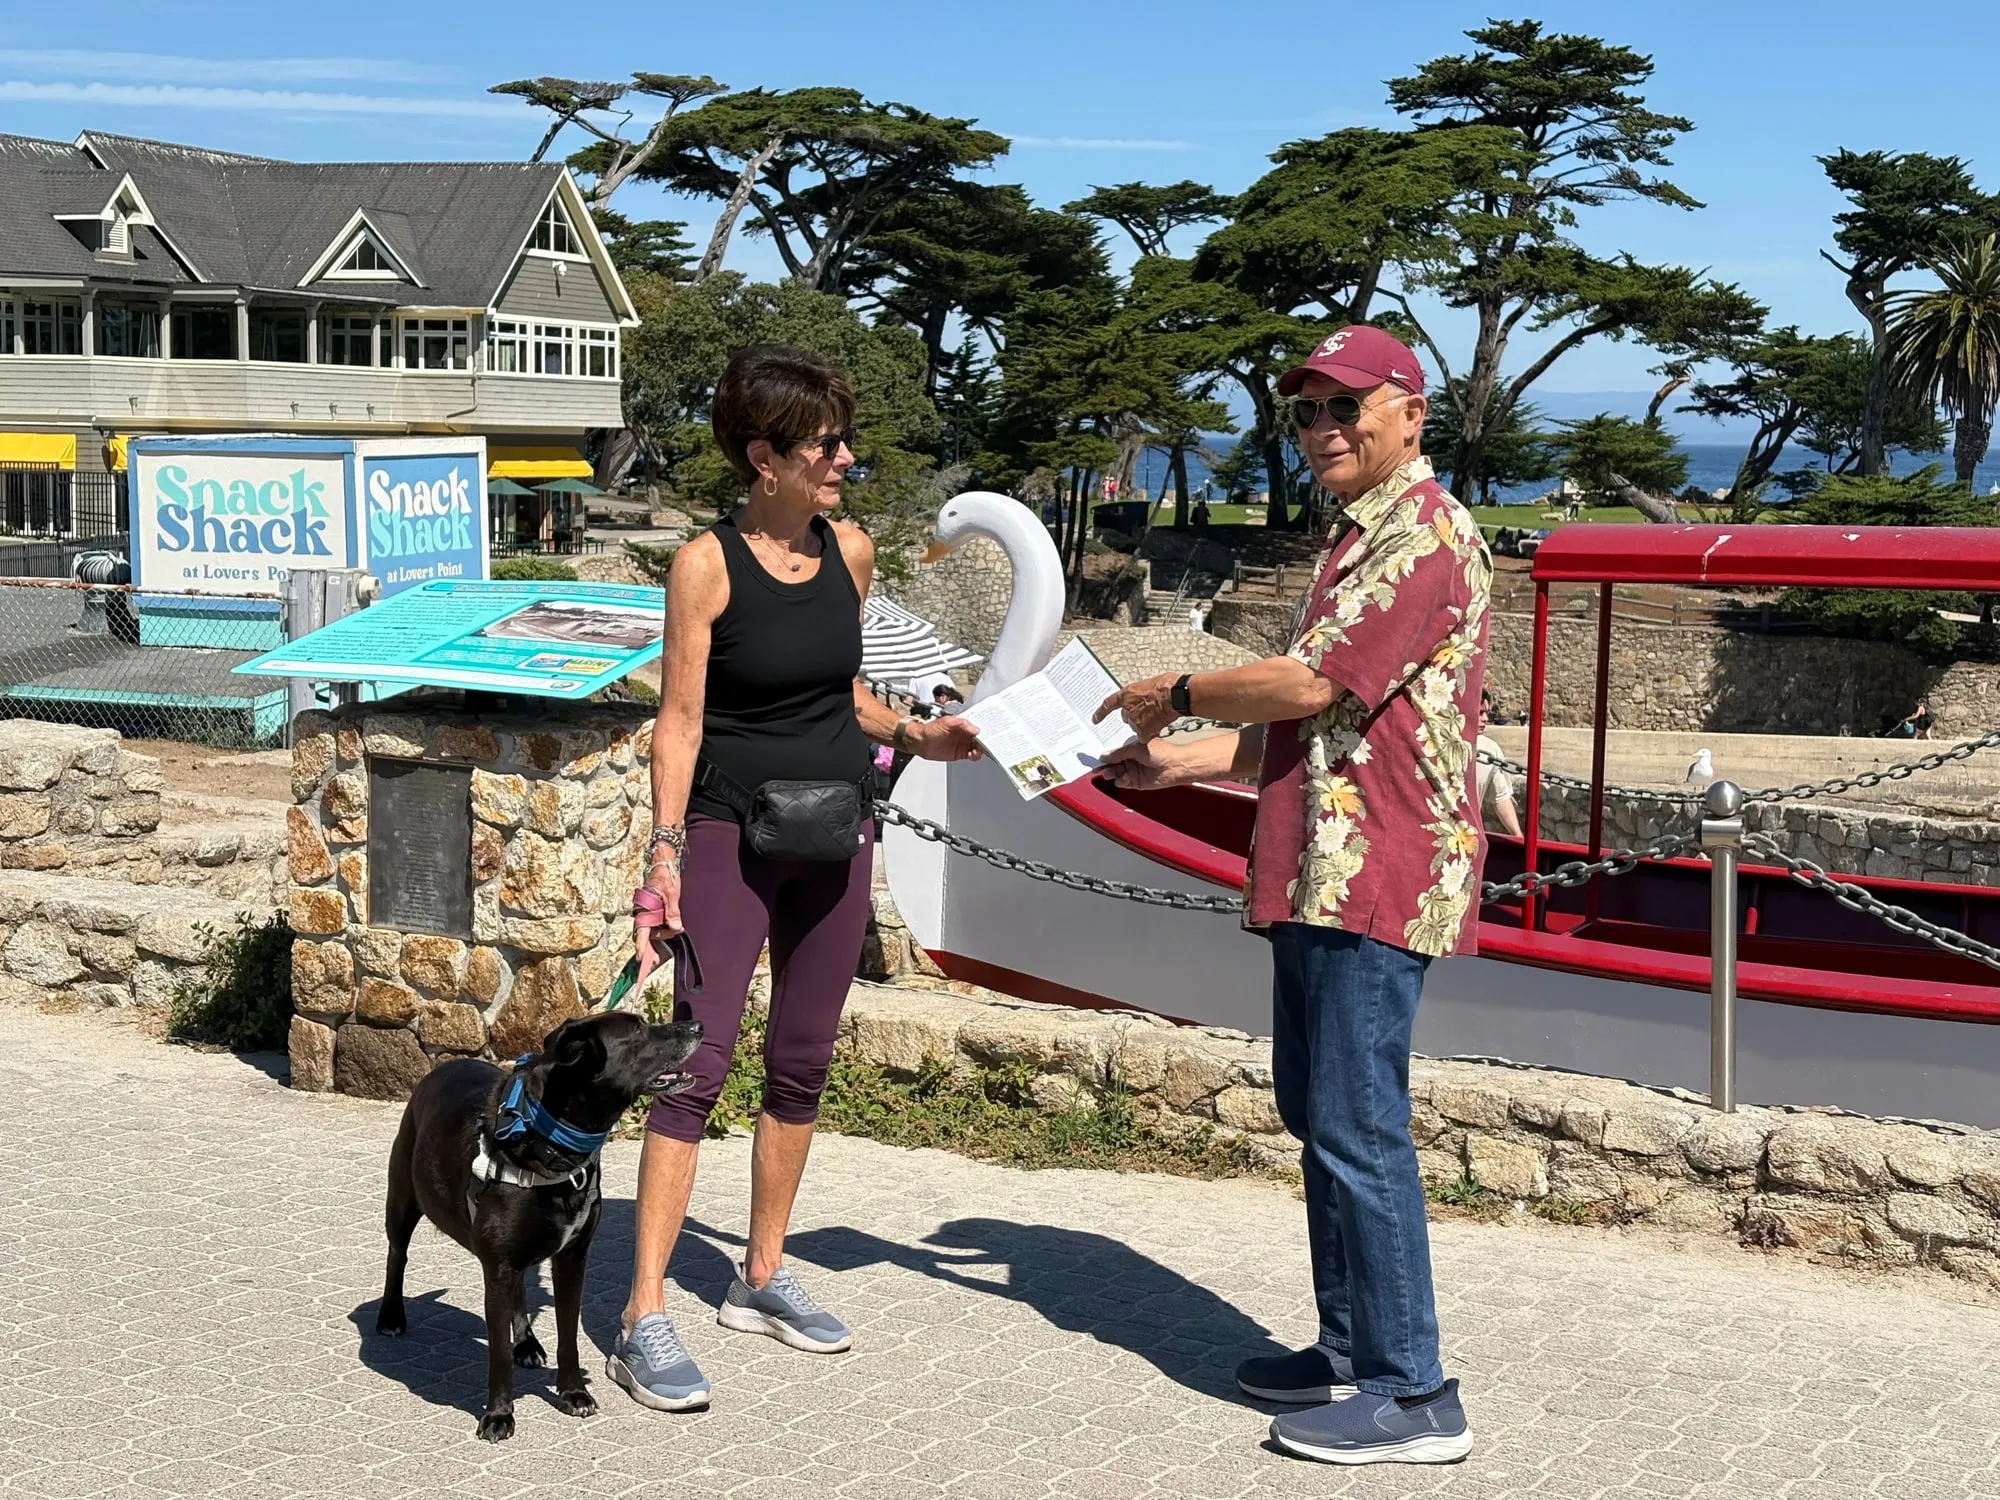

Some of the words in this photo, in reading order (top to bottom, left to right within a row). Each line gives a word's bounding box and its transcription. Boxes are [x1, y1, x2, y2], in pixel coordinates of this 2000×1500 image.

[156, 465, 331, 517] Snack
[369, 466, 472, 517] Snack
[156, 503, 333, 556] Shack
[370, 507, 474, 559] Shack
[183, 566, 199, 578] at
[203, 564, 260, 580] Lovers
[387, 569, 397, 583] at
[400, 566, 434, 581] Lovers
[437, 562, 463, 577] Point
